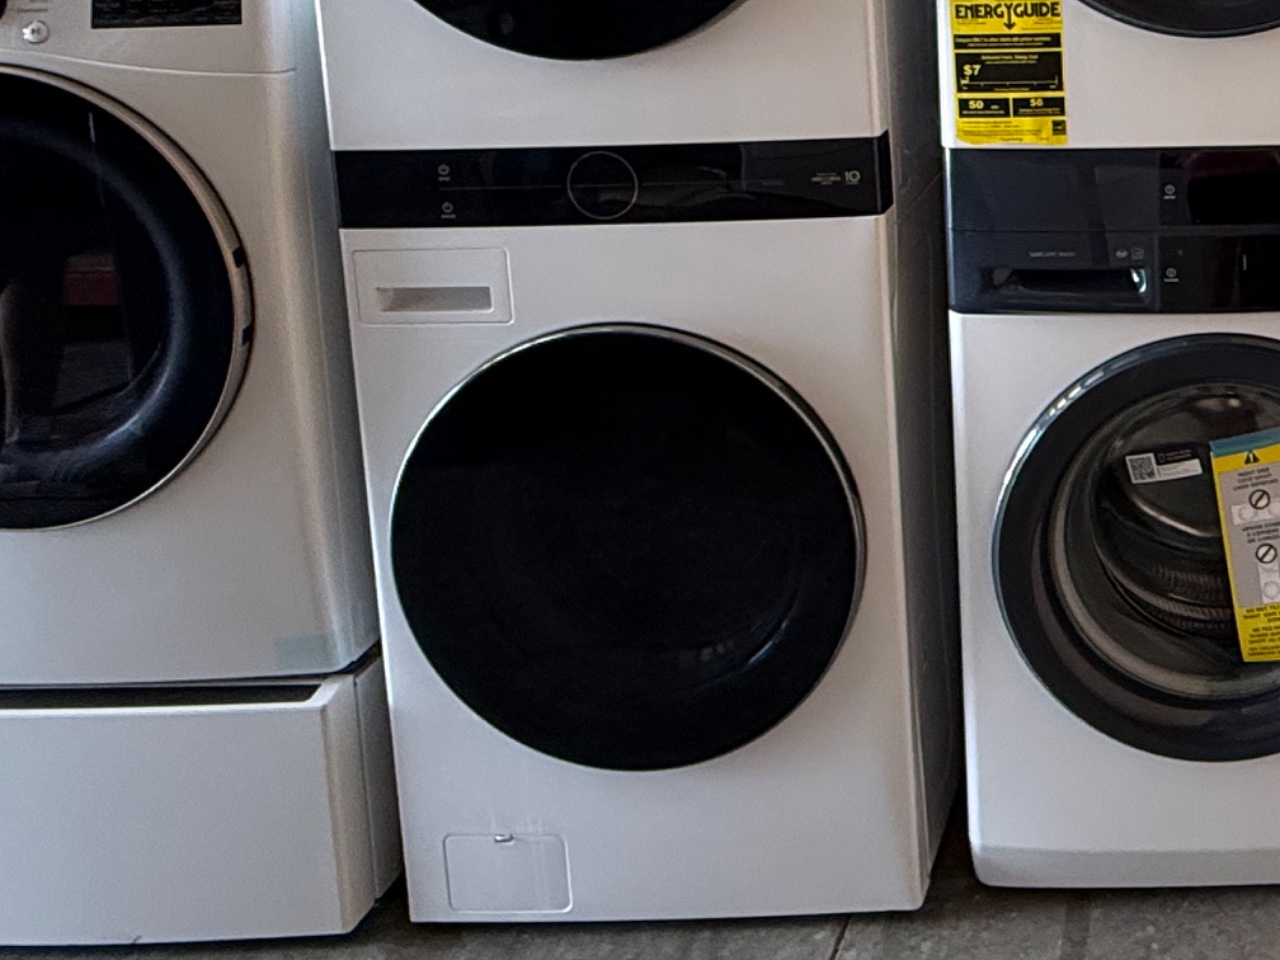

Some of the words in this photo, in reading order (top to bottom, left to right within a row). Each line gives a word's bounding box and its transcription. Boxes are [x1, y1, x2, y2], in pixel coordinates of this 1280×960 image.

[954, 1, 1061, 23] ENERGYGUIDE
[963, 64, 981, 76] $7
[845, 170, 861, 183] 10
